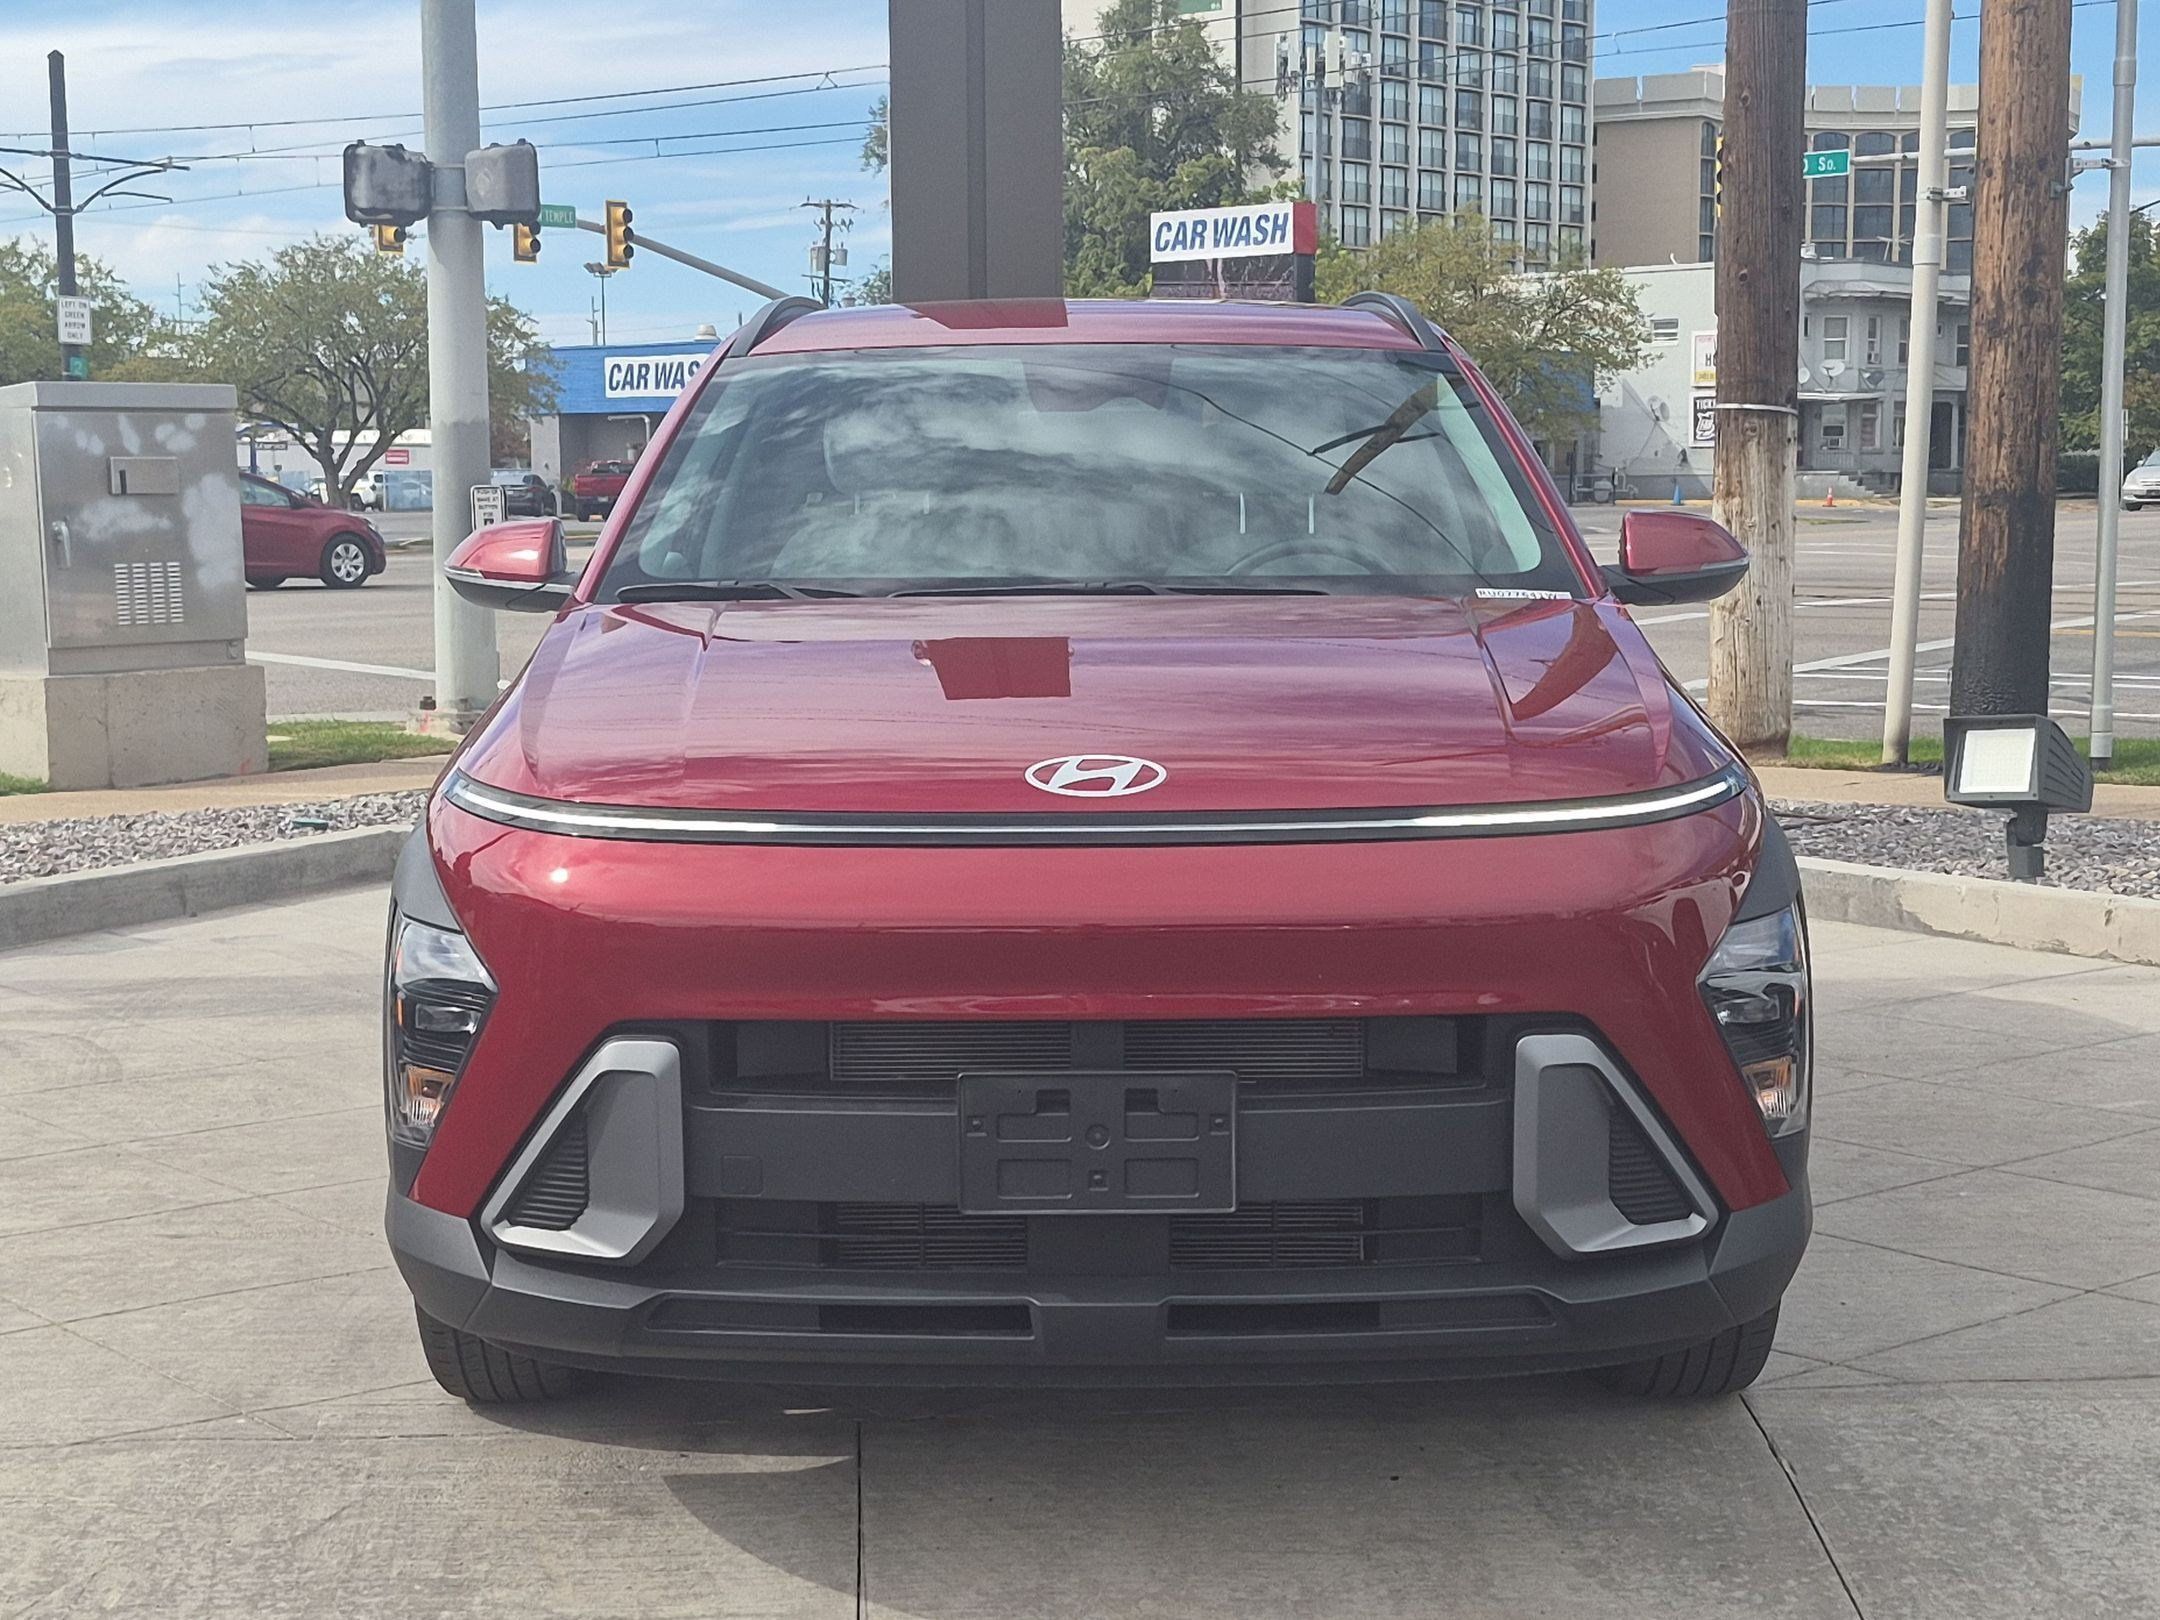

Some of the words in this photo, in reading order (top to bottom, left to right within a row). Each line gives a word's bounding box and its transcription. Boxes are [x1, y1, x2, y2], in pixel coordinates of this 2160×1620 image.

[545, 209, 574, 224] TEMPLE
[1155, 219, 1207, 252] CAR
[1213, 213, 1289, 248] WASH
[61, 300, 76, 309] LEFT
[64, 321, 86, 329] ARROW
[608, 362, 651, 391] CAR
[654, 360, 701, 390] WAS
